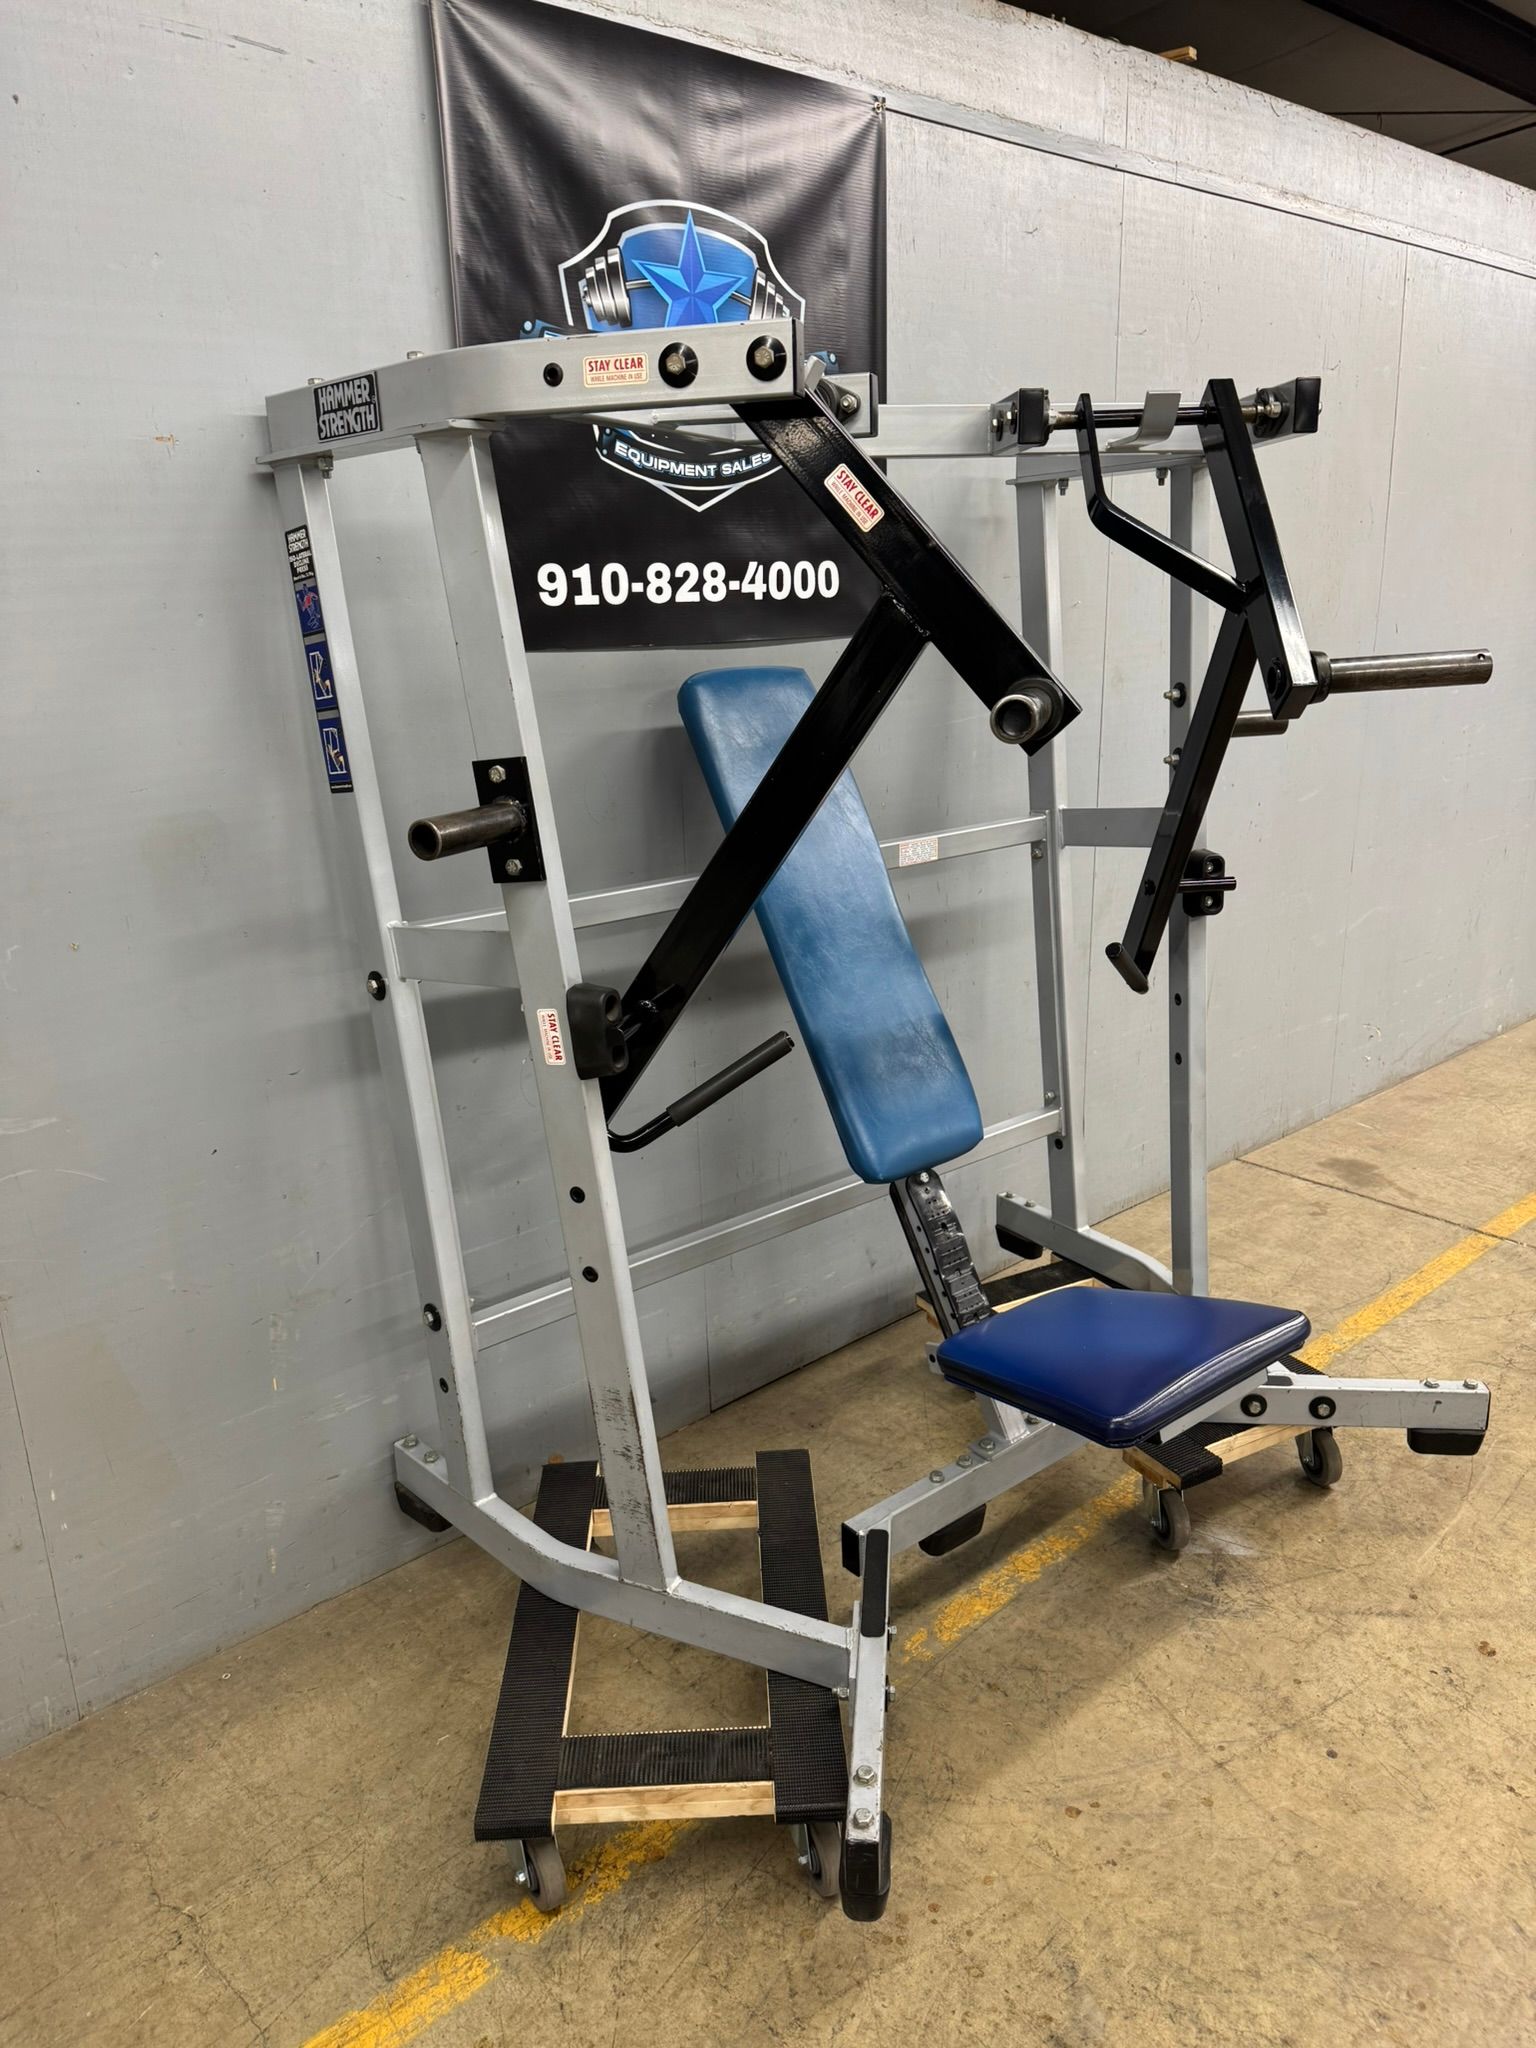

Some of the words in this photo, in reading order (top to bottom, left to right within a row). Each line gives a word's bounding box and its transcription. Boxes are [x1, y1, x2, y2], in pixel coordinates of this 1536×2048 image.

[587, 360, 611, 373] STAY
[613, 357, 644, 370] CLEAR
[318, 377, 370, 414] HAMMER
[319, 404, 376, 438] STRENGTH
[613, 439, 718, 478] EQUIPMENT
[721, 452, 773, 476] SALES
[836, 470, 857, 492] STAY
[854, 491, 879, 519] CLEAR
[536, 560, 840, 608] 910-828-4000
[547, 1013, 559, 1033] STAY
[551, 1035, 563, 1061] CLEAR
